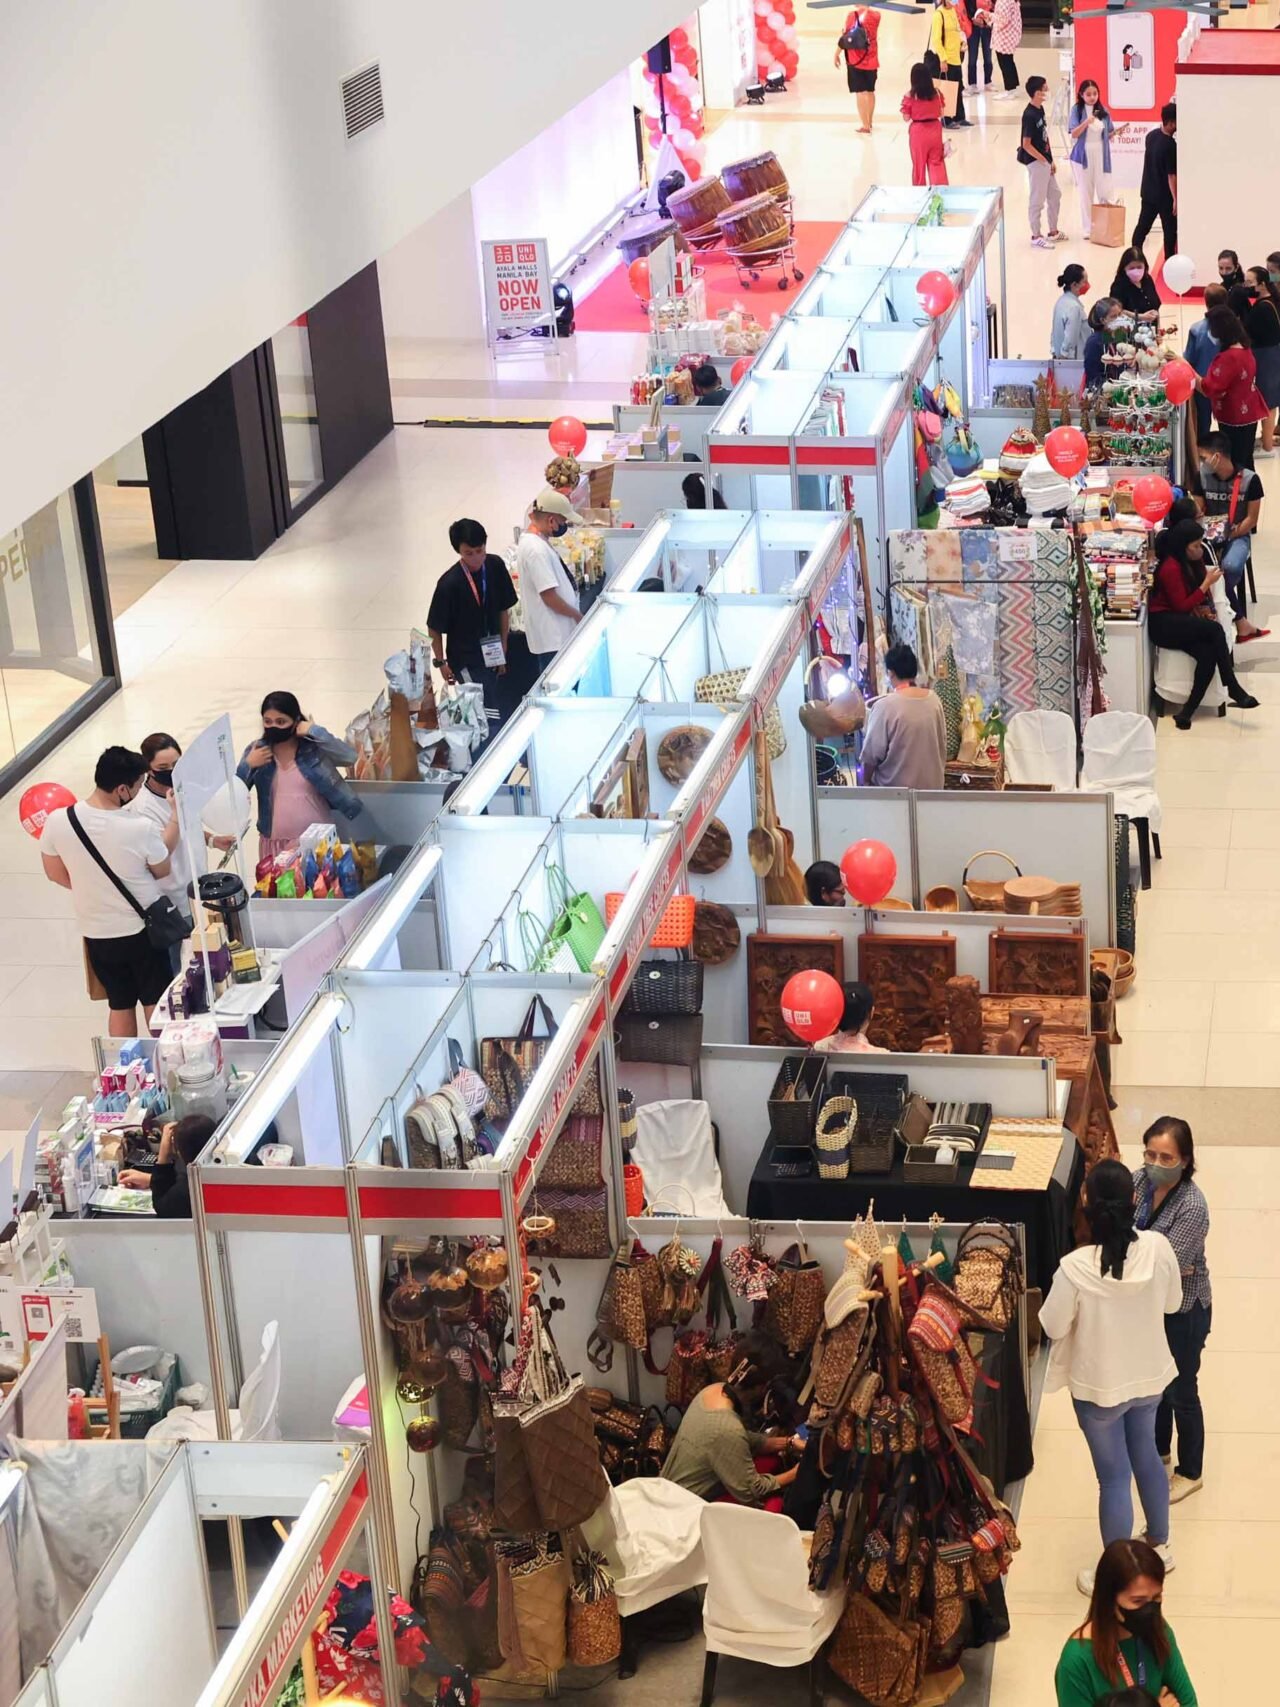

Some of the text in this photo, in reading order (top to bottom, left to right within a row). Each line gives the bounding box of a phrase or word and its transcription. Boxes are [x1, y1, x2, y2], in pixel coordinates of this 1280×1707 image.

[498, 279, 539, 296] NOW
[500, 296, 541, 312] OPEN
[266, 1555, 326, 1681] MARKETING
